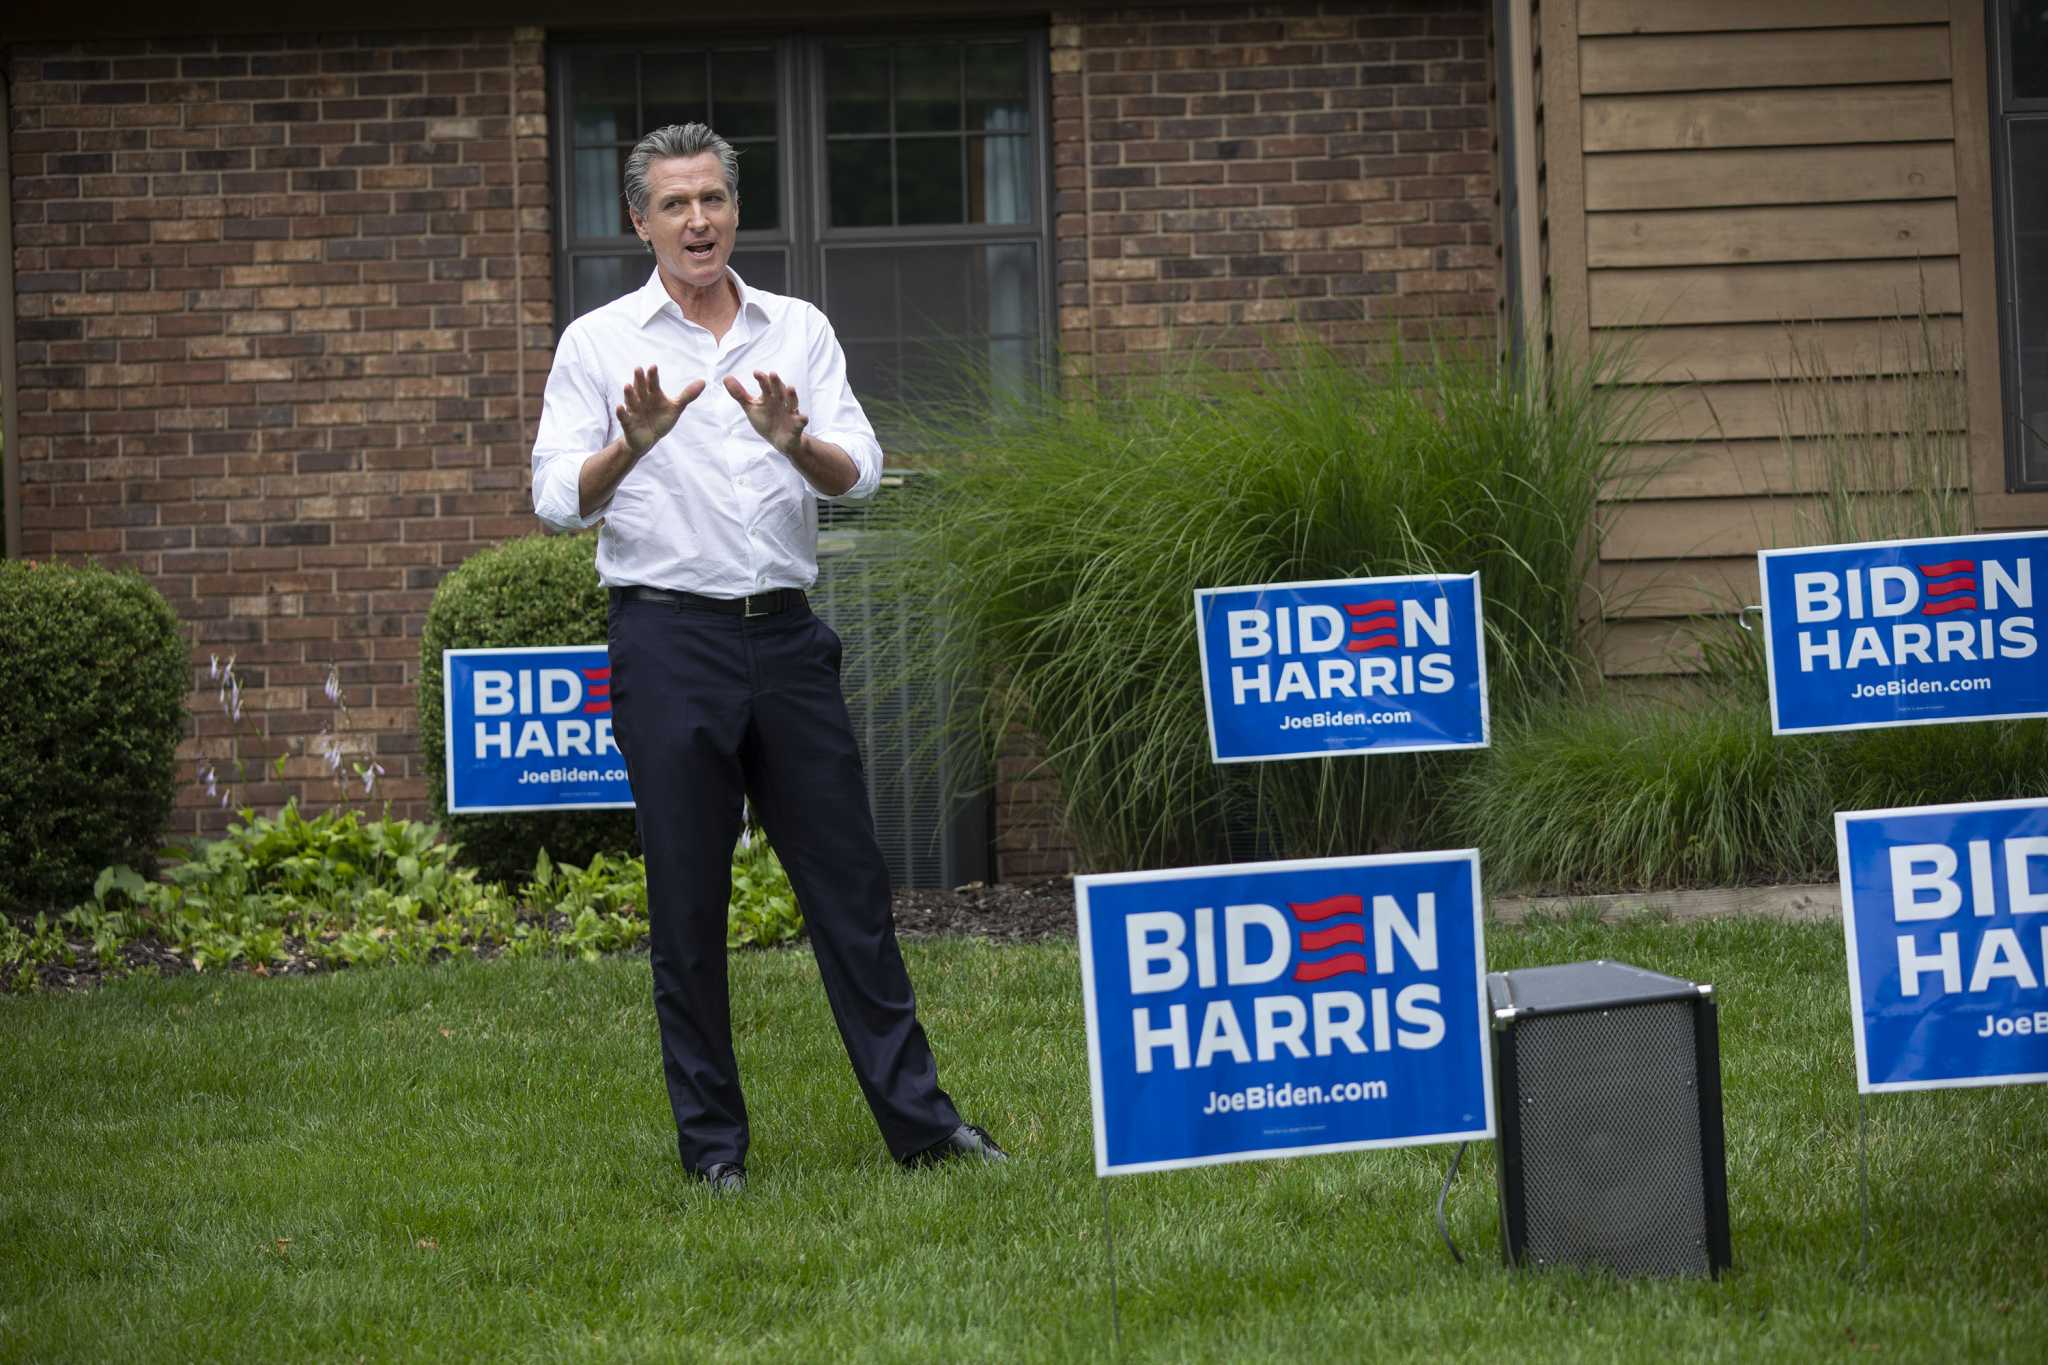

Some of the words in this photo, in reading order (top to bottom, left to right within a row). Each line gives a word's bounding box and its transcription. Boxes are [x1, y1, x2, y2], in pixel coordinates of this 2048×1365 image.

[1794, 558, 2034, 624] BIDEN
[1227, 597, 1451, 659] BIDEN
[1798, 616, 2039, 672] HARRIS
[473, 668, 612, 716] BIDE
[1231, 653, 1455, 705] HARRIS
[1851, 677, 1991, 698] JoeBiden.com
[474, 718, 622, 759] HARR
[1279, 710, 1412, 730] JoeBiden.com
[518, 767, 629, 784] JoeBiden.co
[1888, 836, 2048, 922] BID
[1125, 892, 1439, 995] BIDEN
[1132, 983, 1446, 1073] HARRIS
[1203, 1080, 1388, 1115] JoeBiden.com
